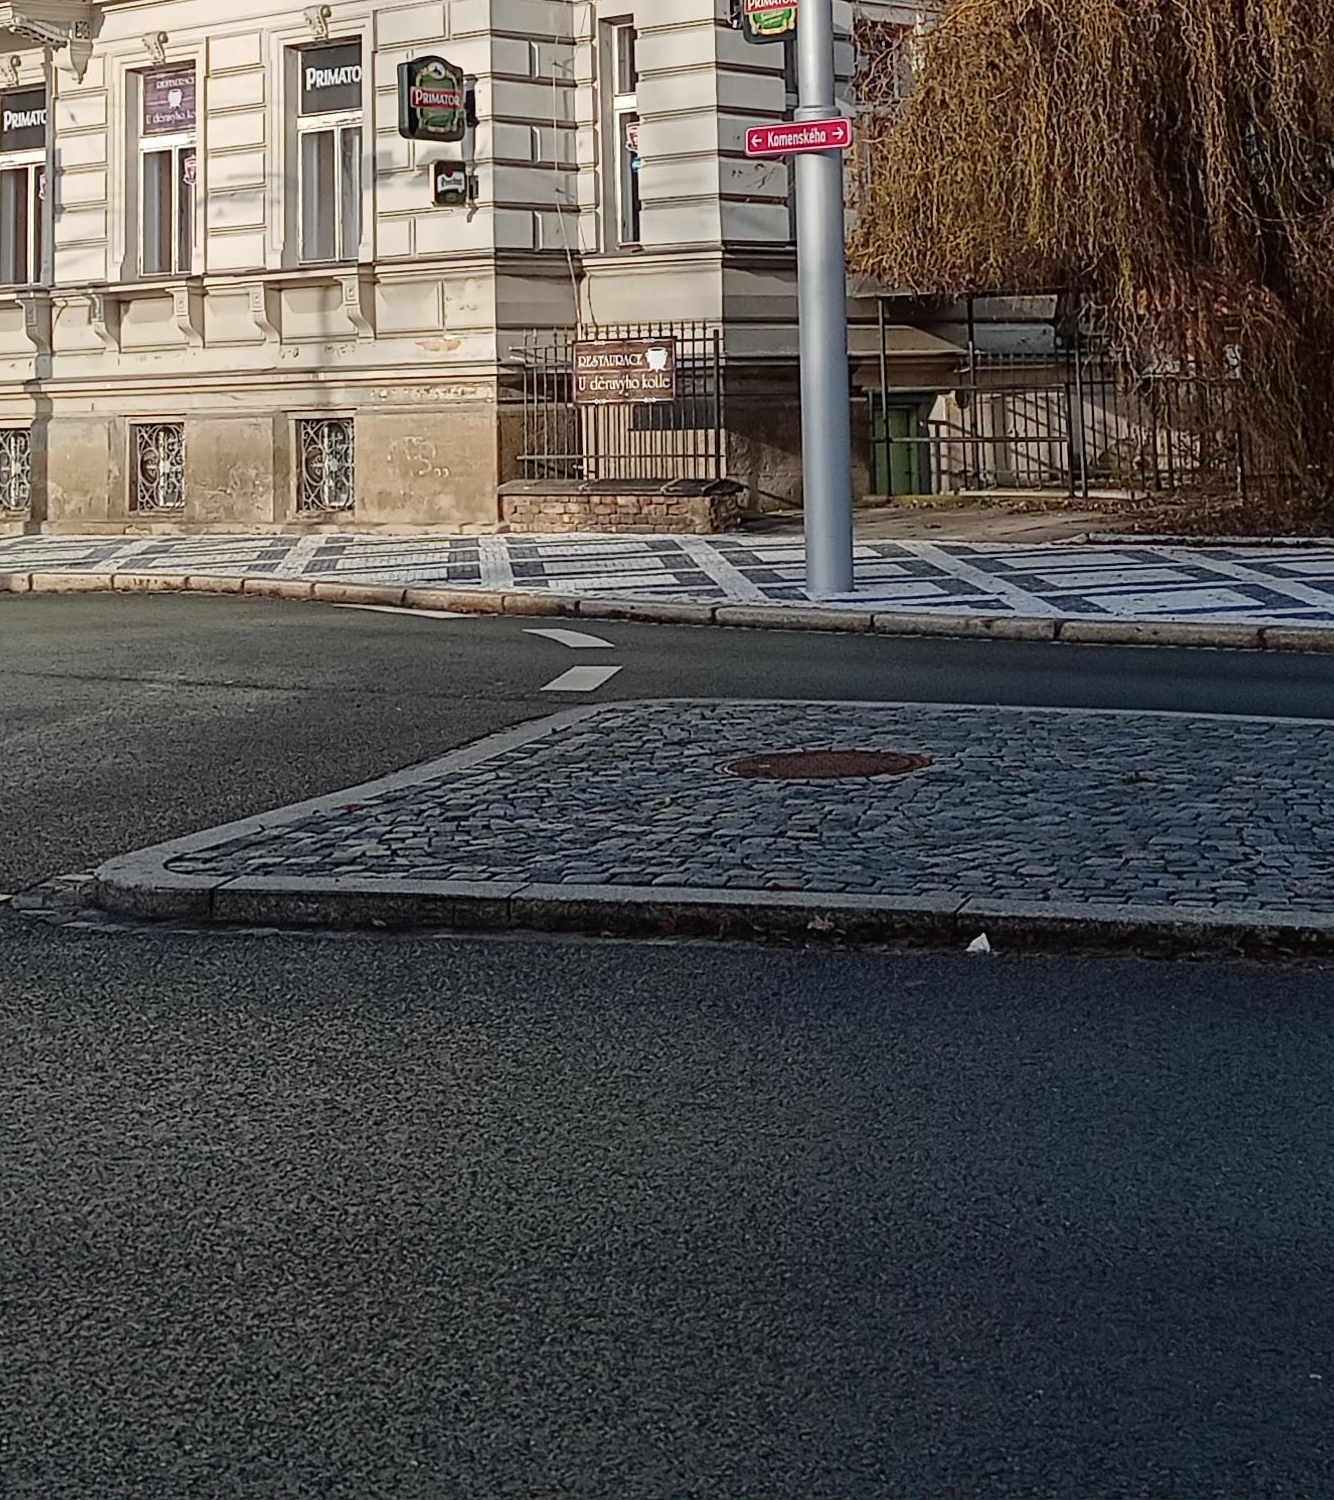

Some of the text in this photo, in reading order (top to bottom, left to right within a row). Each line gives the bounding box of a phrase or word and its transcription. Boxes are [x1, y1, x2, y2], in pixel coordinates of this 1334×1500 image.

[415, 89, 460, 106] PRIMATOR
[767, 128, 827, 148] Komenského
[578, 353, 643, 368] RESTAURACE
[578, 373, 671, 395] U děravýho kotle
